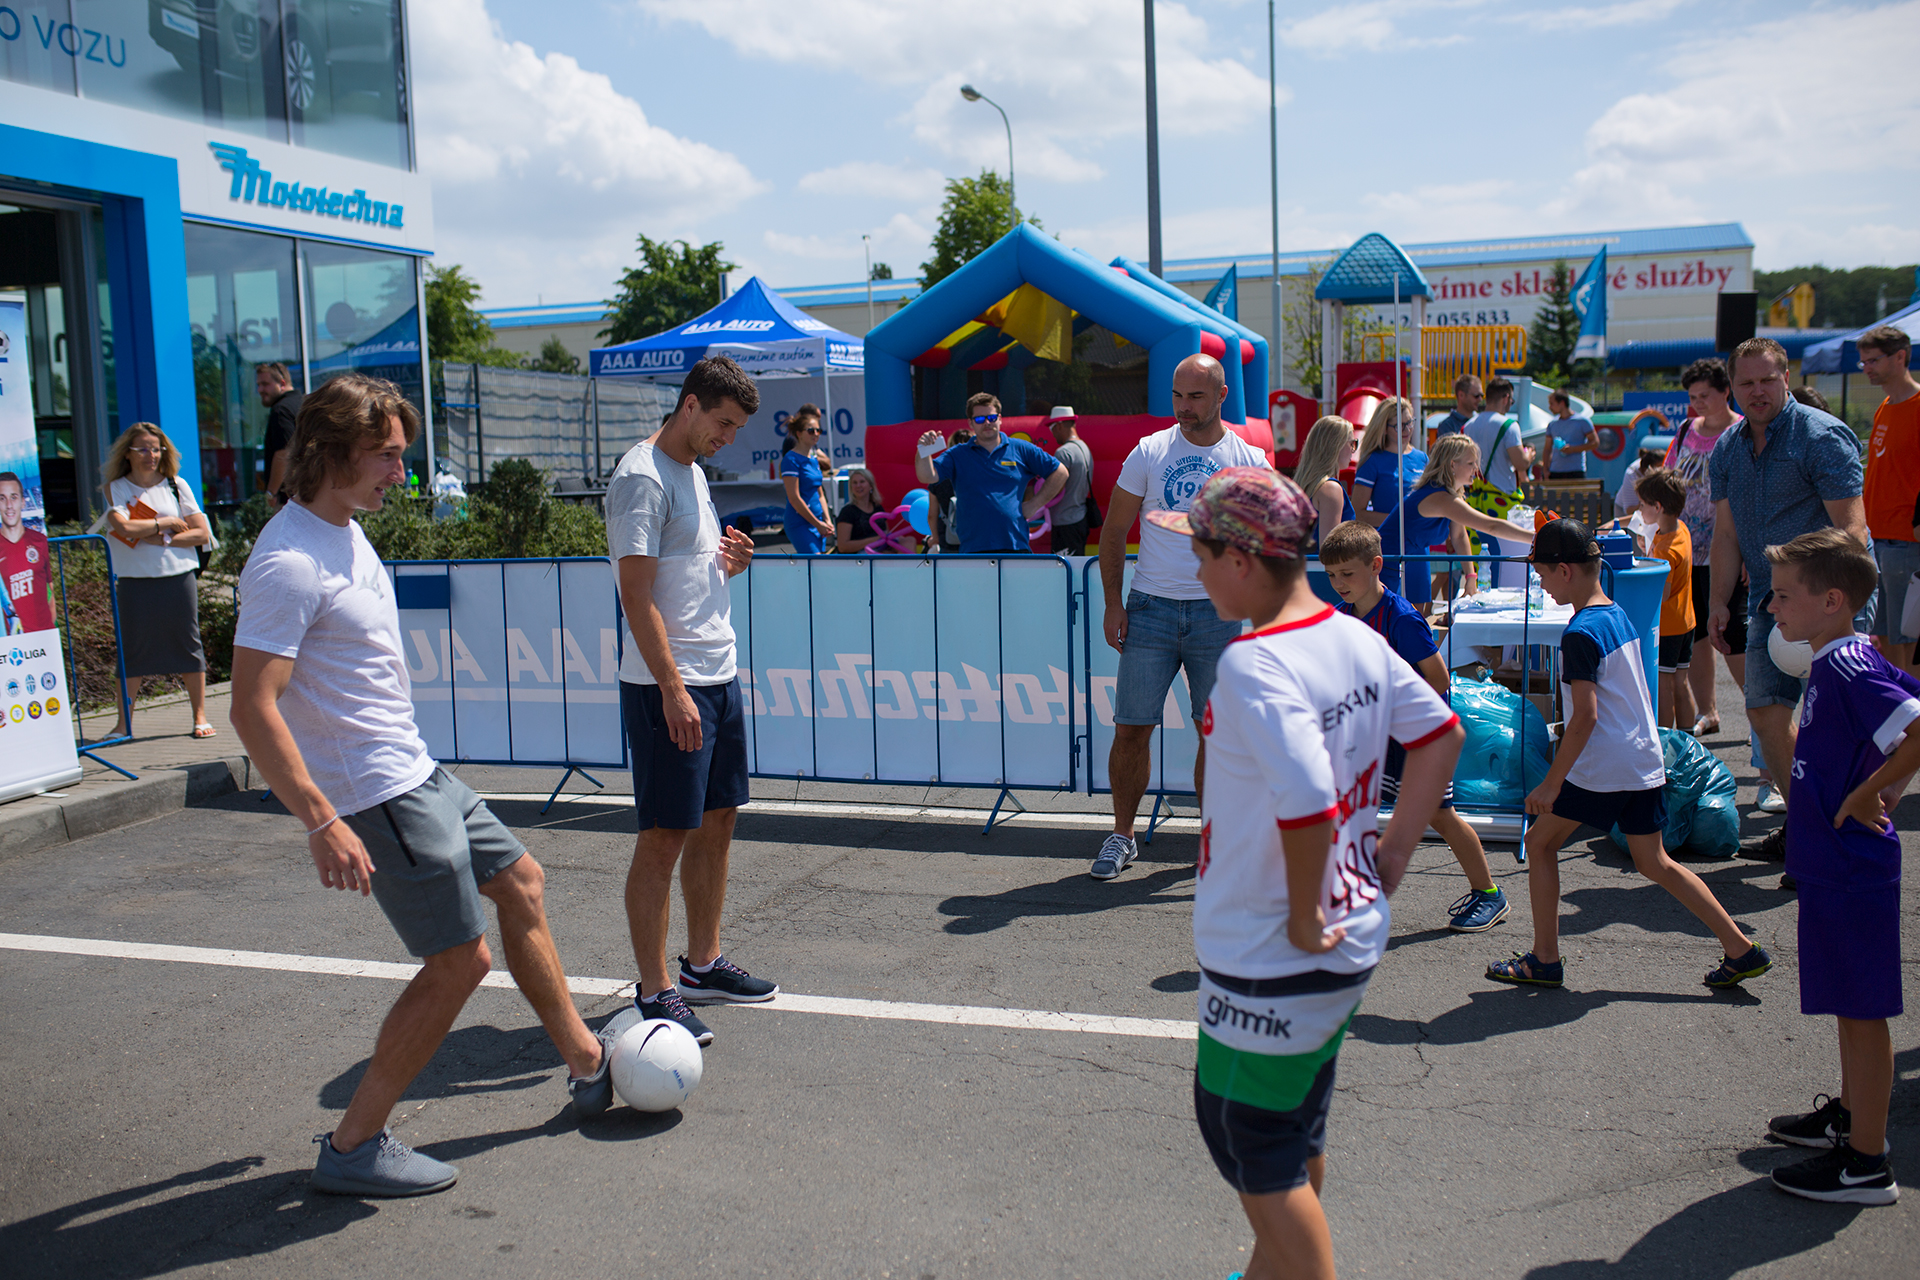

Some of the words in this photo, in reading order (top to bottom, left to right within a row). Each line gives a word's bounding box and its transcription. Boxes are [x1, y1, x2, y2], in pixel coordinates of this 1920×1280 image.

[32, 14, 126, 68] VOZU
[209, 141, 403, 228] Mototechna
[1636, 259, 1734, 291] služby
[680, 320, 723, 335] AAA
[723, 319, 776, 331] AUTO
[1437, 312, 1471, 326] 055
[1476, 310, 1510, 326] 833
[600, 352, 636, 369] AAA
[640, 349, 685, 367] AUTO
[1160, 465, 1175, 482] FIRST
[10, 576, 34, 600] BET
[24, 648, 47, 660] LIGA
[1204, 994, 1291, 1040] gimmik
